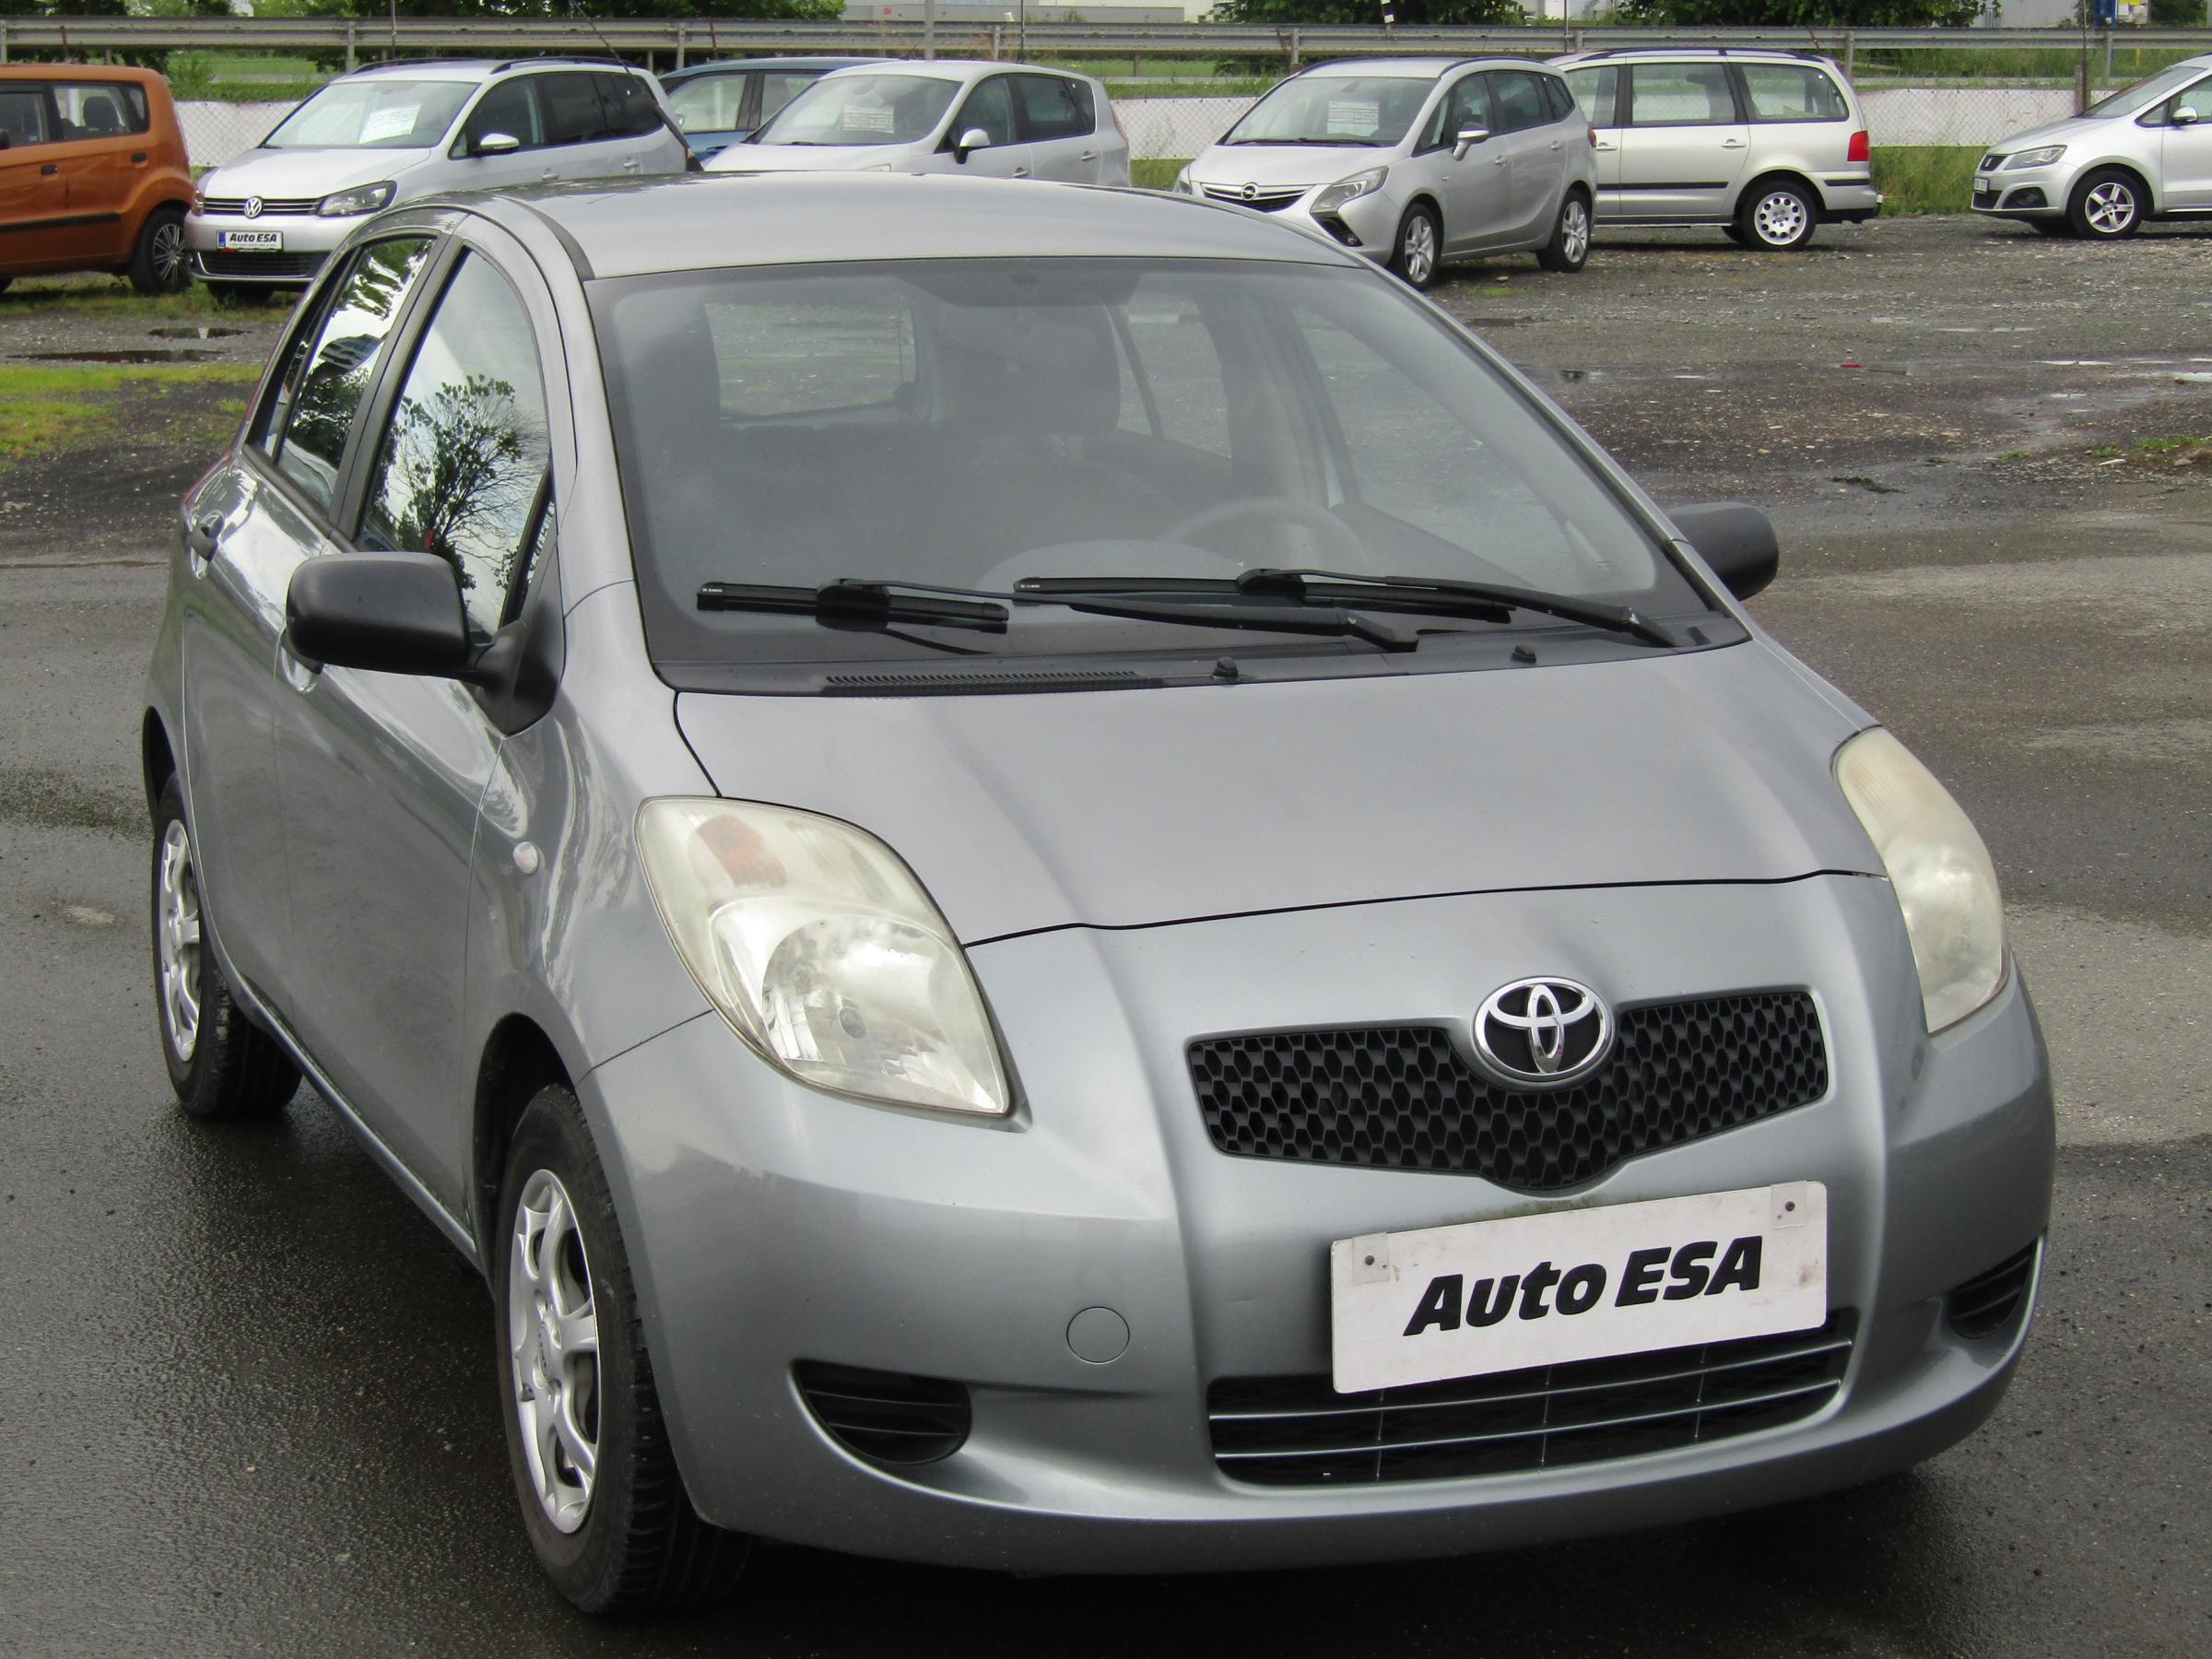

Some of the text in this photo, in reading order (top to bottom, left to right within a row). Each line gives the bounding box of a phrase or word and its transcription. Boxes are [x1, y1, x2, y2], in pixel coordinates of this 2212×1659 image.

[229, 233, 277, 242] Auto ESA
[1403, 1235, 1763, 1336] Auto ESA
